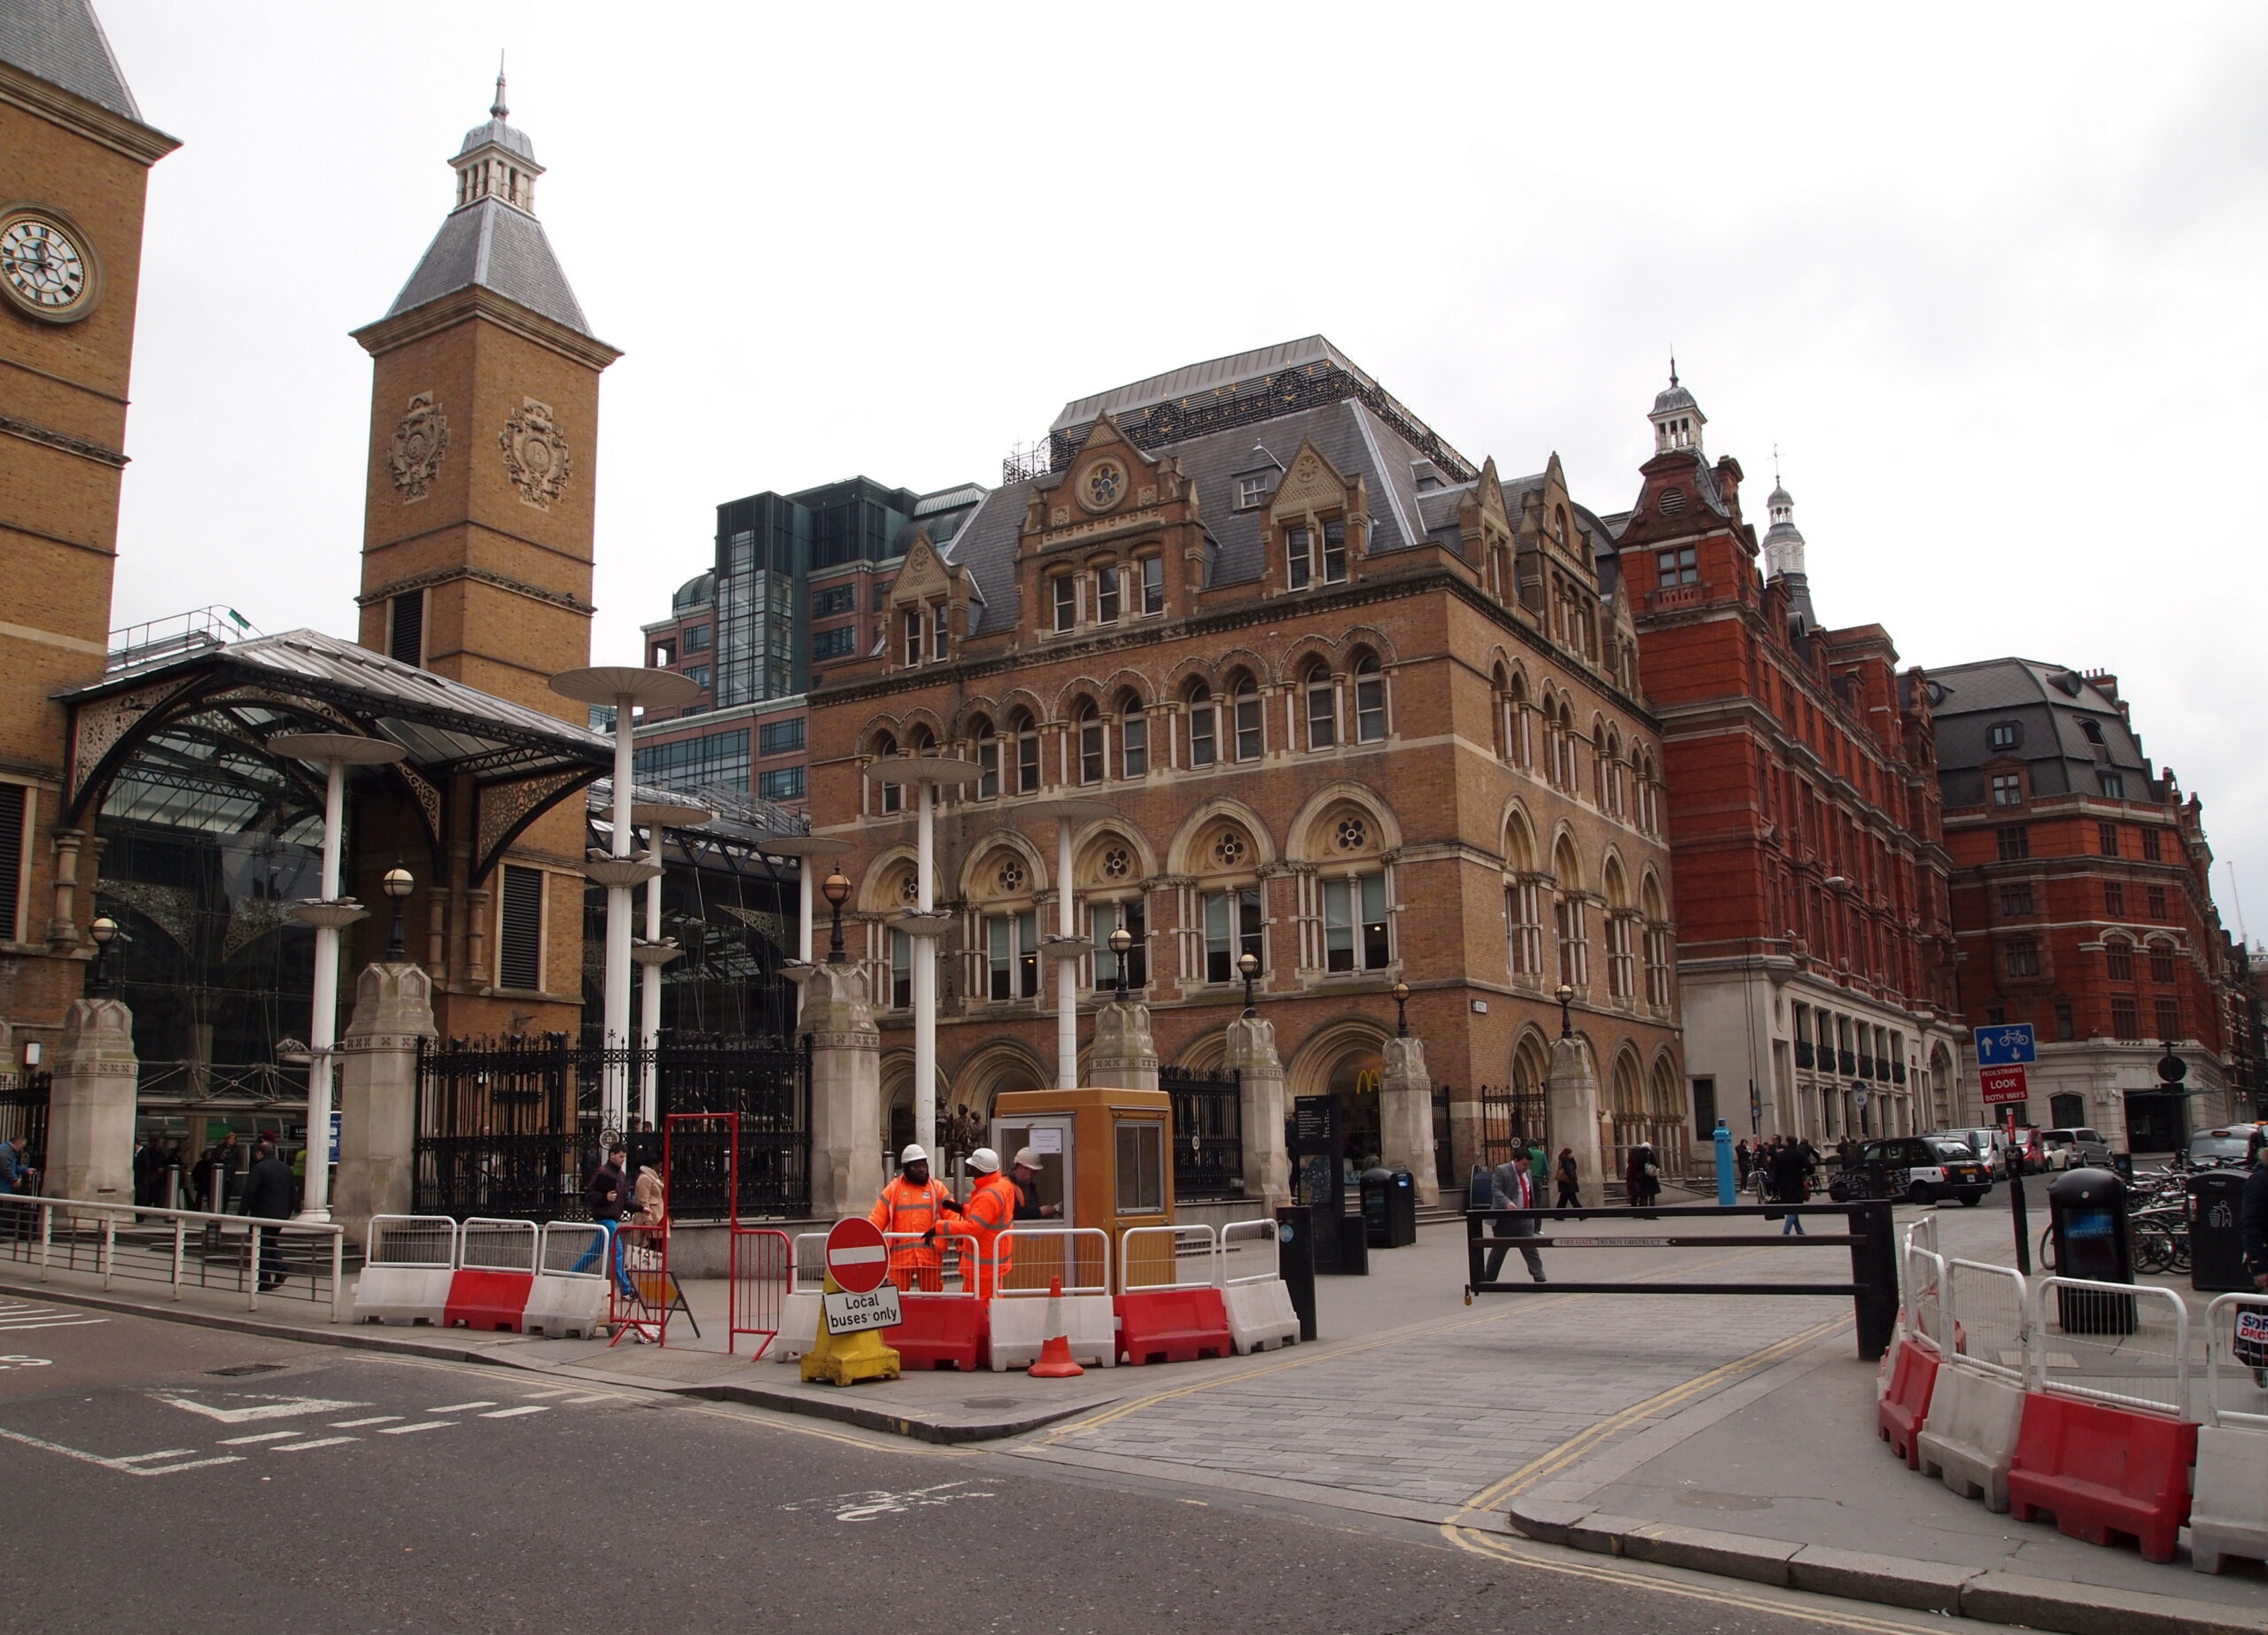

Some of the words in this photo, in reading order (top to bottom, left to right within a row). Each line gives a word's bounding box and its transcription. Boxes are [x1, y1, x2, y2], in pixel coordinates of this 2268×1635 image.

[1981, 1066, 2023, 1077] PEDESTRIANS
[1990, 1079, 2017, 1089] LOOK
[1984, 1093, 2004, 1102] BOTH
[845, 1293, 879, 1310] Local
[830, 1312, 867, 1328] buses
[873, 1306, 897, 1322] only
